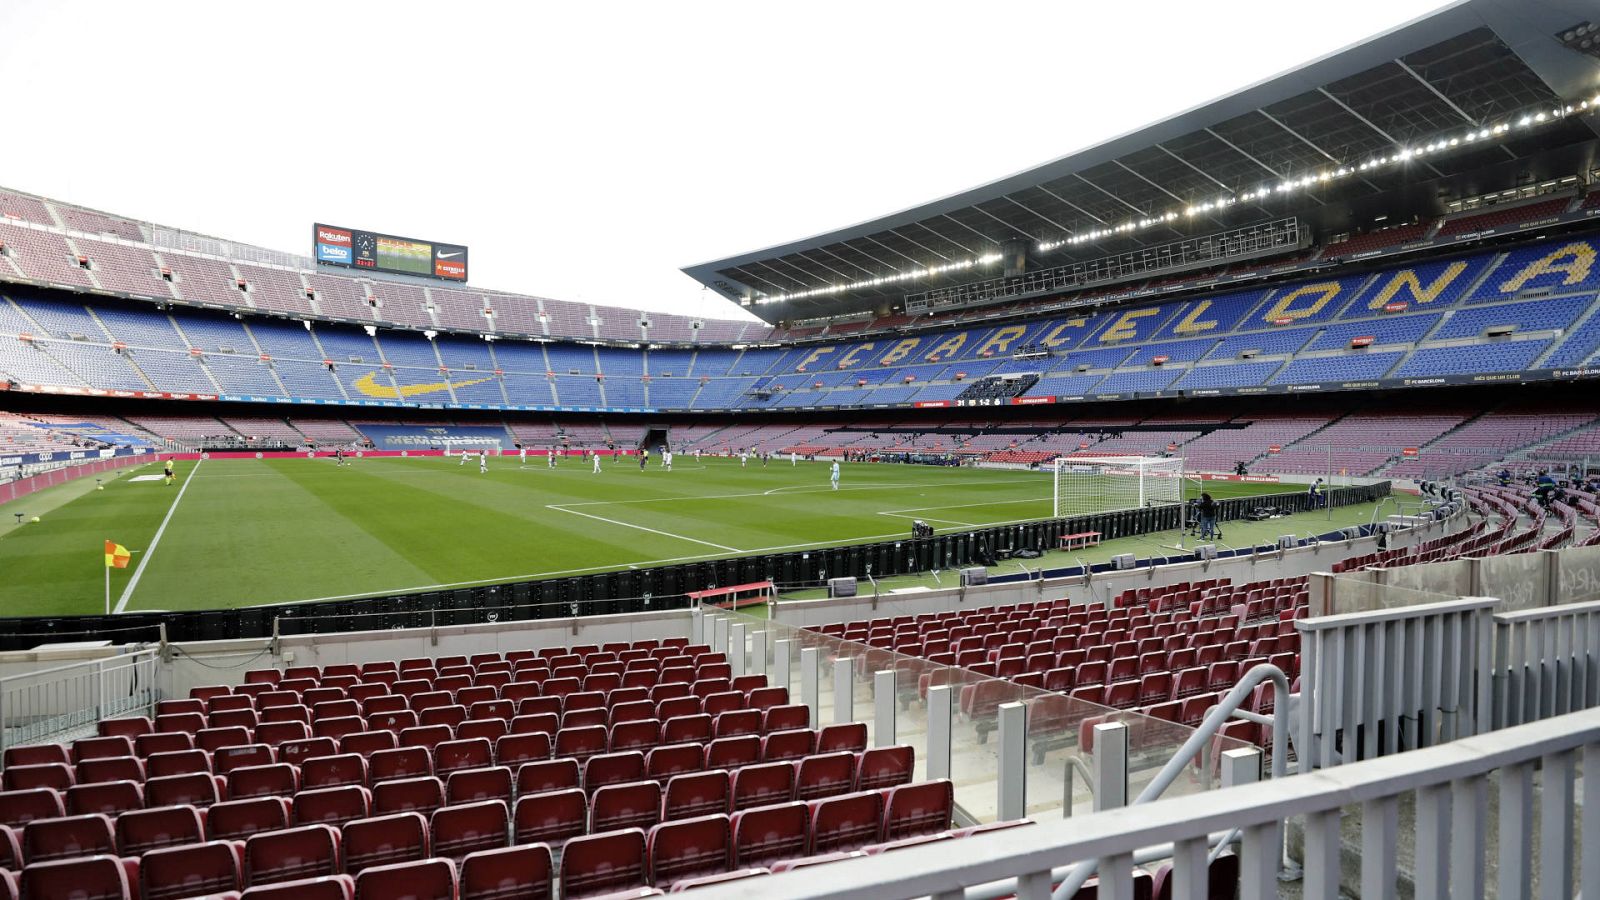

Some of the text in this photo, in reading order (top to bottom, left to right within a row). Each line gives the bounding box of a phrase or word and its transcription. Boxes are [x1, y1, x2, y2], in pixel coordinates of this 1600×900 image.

[319, 230, 350, 242] Rakuten
[322, 245, 348, 256] beko
[796, 241, 1597, 372] FC BARCELONA
